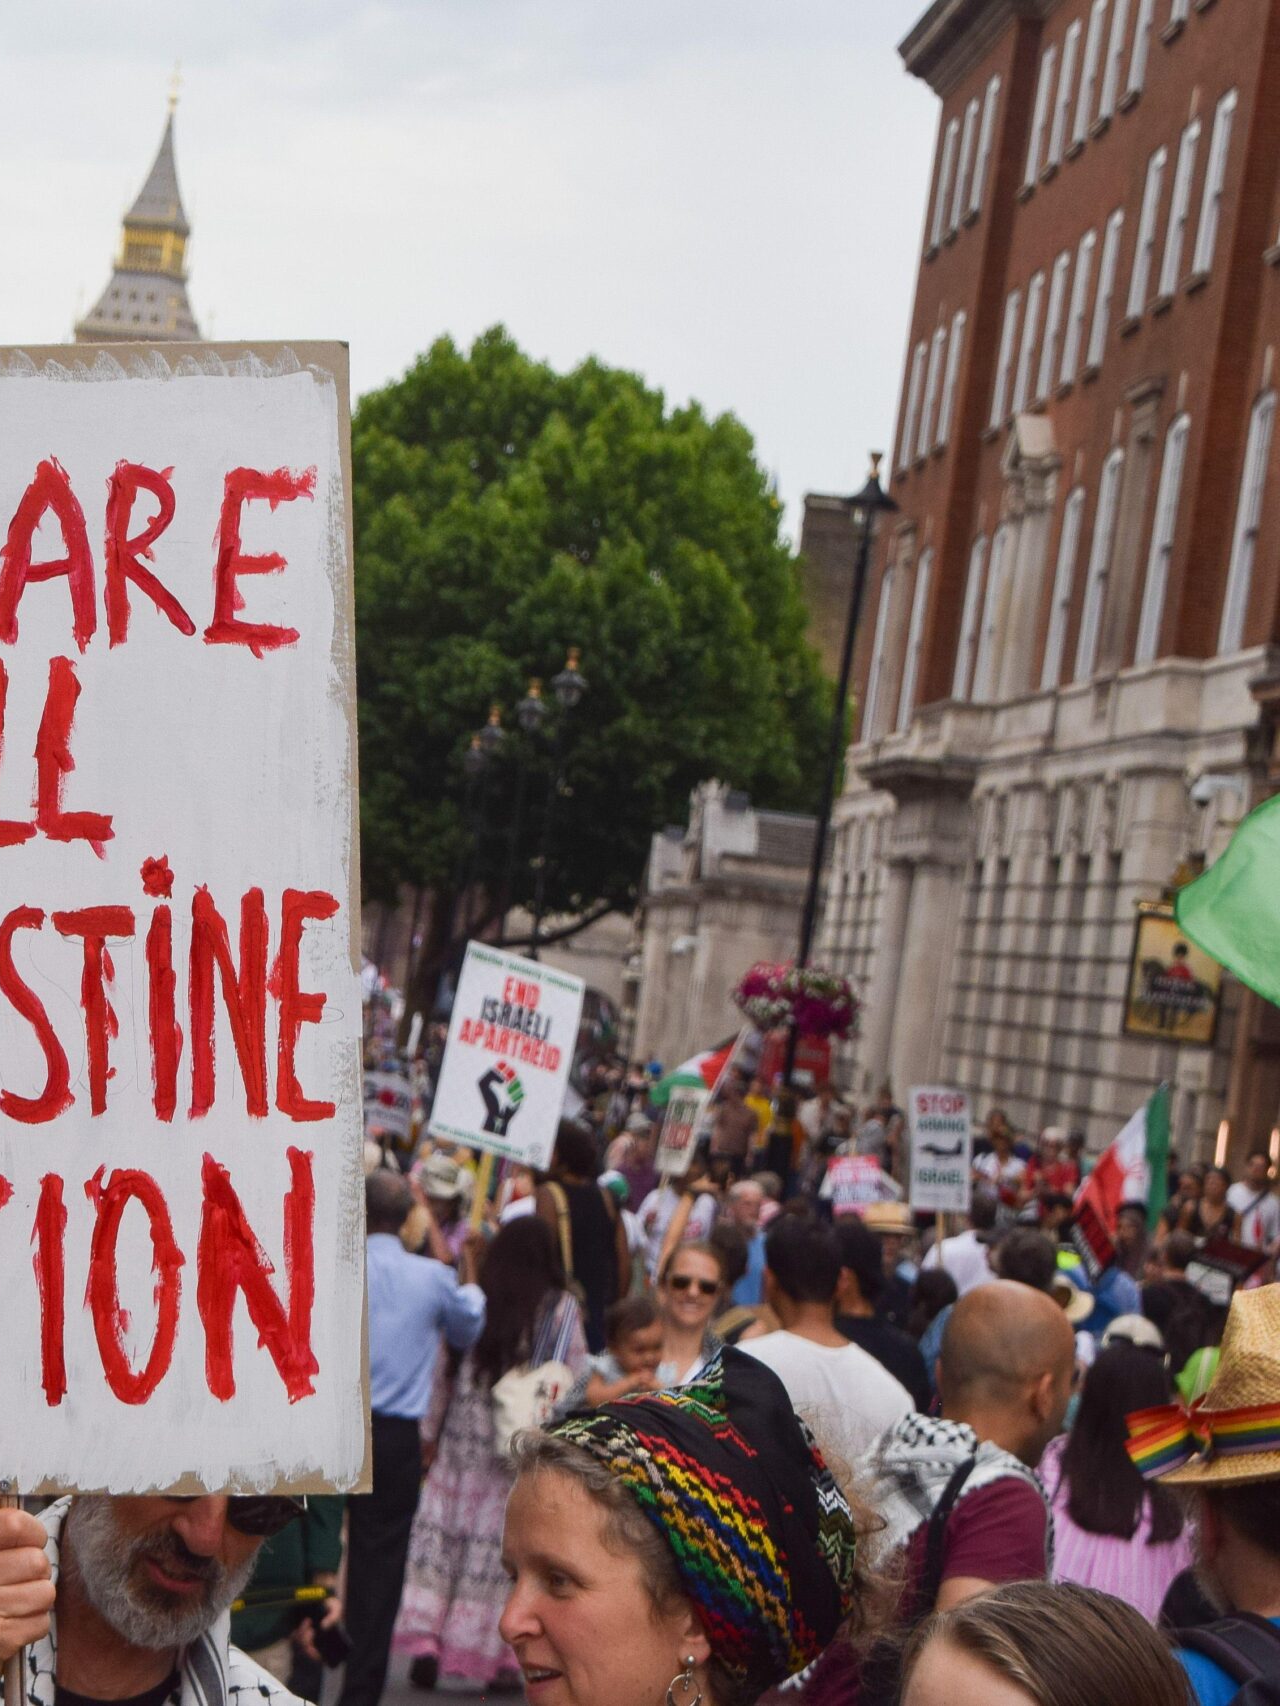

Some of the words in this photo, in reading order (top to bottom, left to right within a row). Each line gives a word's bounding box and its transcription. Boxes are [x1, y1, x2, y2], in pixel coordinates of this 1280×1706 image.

[501, 975, 541, 1010] END
[480, 997, 551, 1040] ISRAELI
[458, 1017, 561, 1073] APARTHEID
[915, 1092, 965, 1115] STOP
[915, 1168, 965, 1185] ISRAEL
